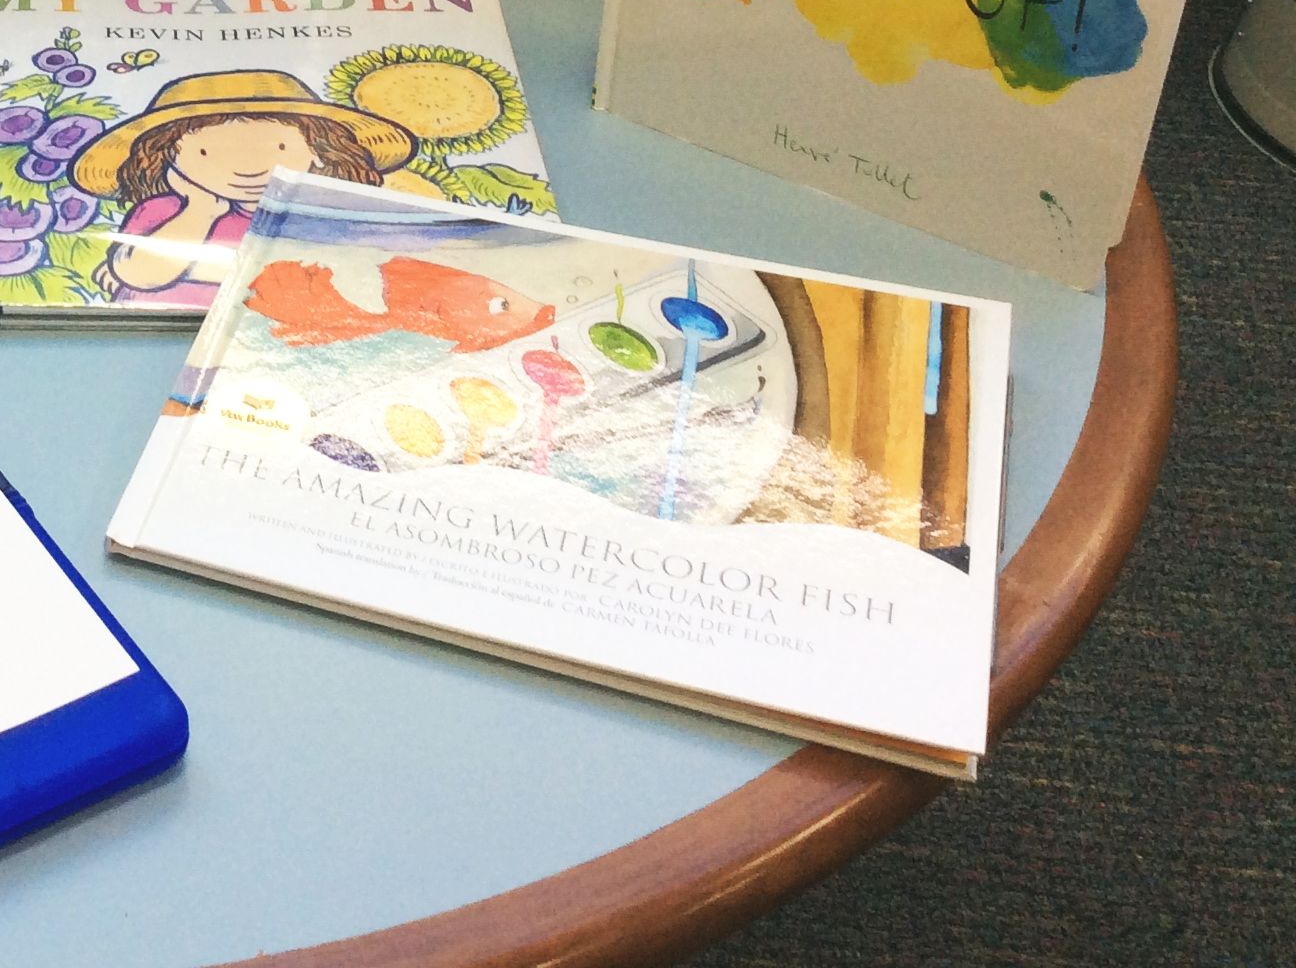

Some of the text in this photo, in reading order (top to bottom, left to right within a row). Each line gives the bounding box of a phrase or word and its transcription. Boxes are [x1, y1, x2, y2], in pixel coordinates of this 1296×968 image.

[104, 23, 354, 43] KEVIN HENKES
[246, 413, 291, 432] Books
[201, 444, 895, 626] THE AMAZING WATERCOLOR FISH
[350, 511, 779, 626] EL ASOMBROSO PEZ ACUARELA
[561, 601, 637, 628] CARMEN
[599, 592, 693, 627] CAROLYN
[743, 626, 815, 655] FLORES
